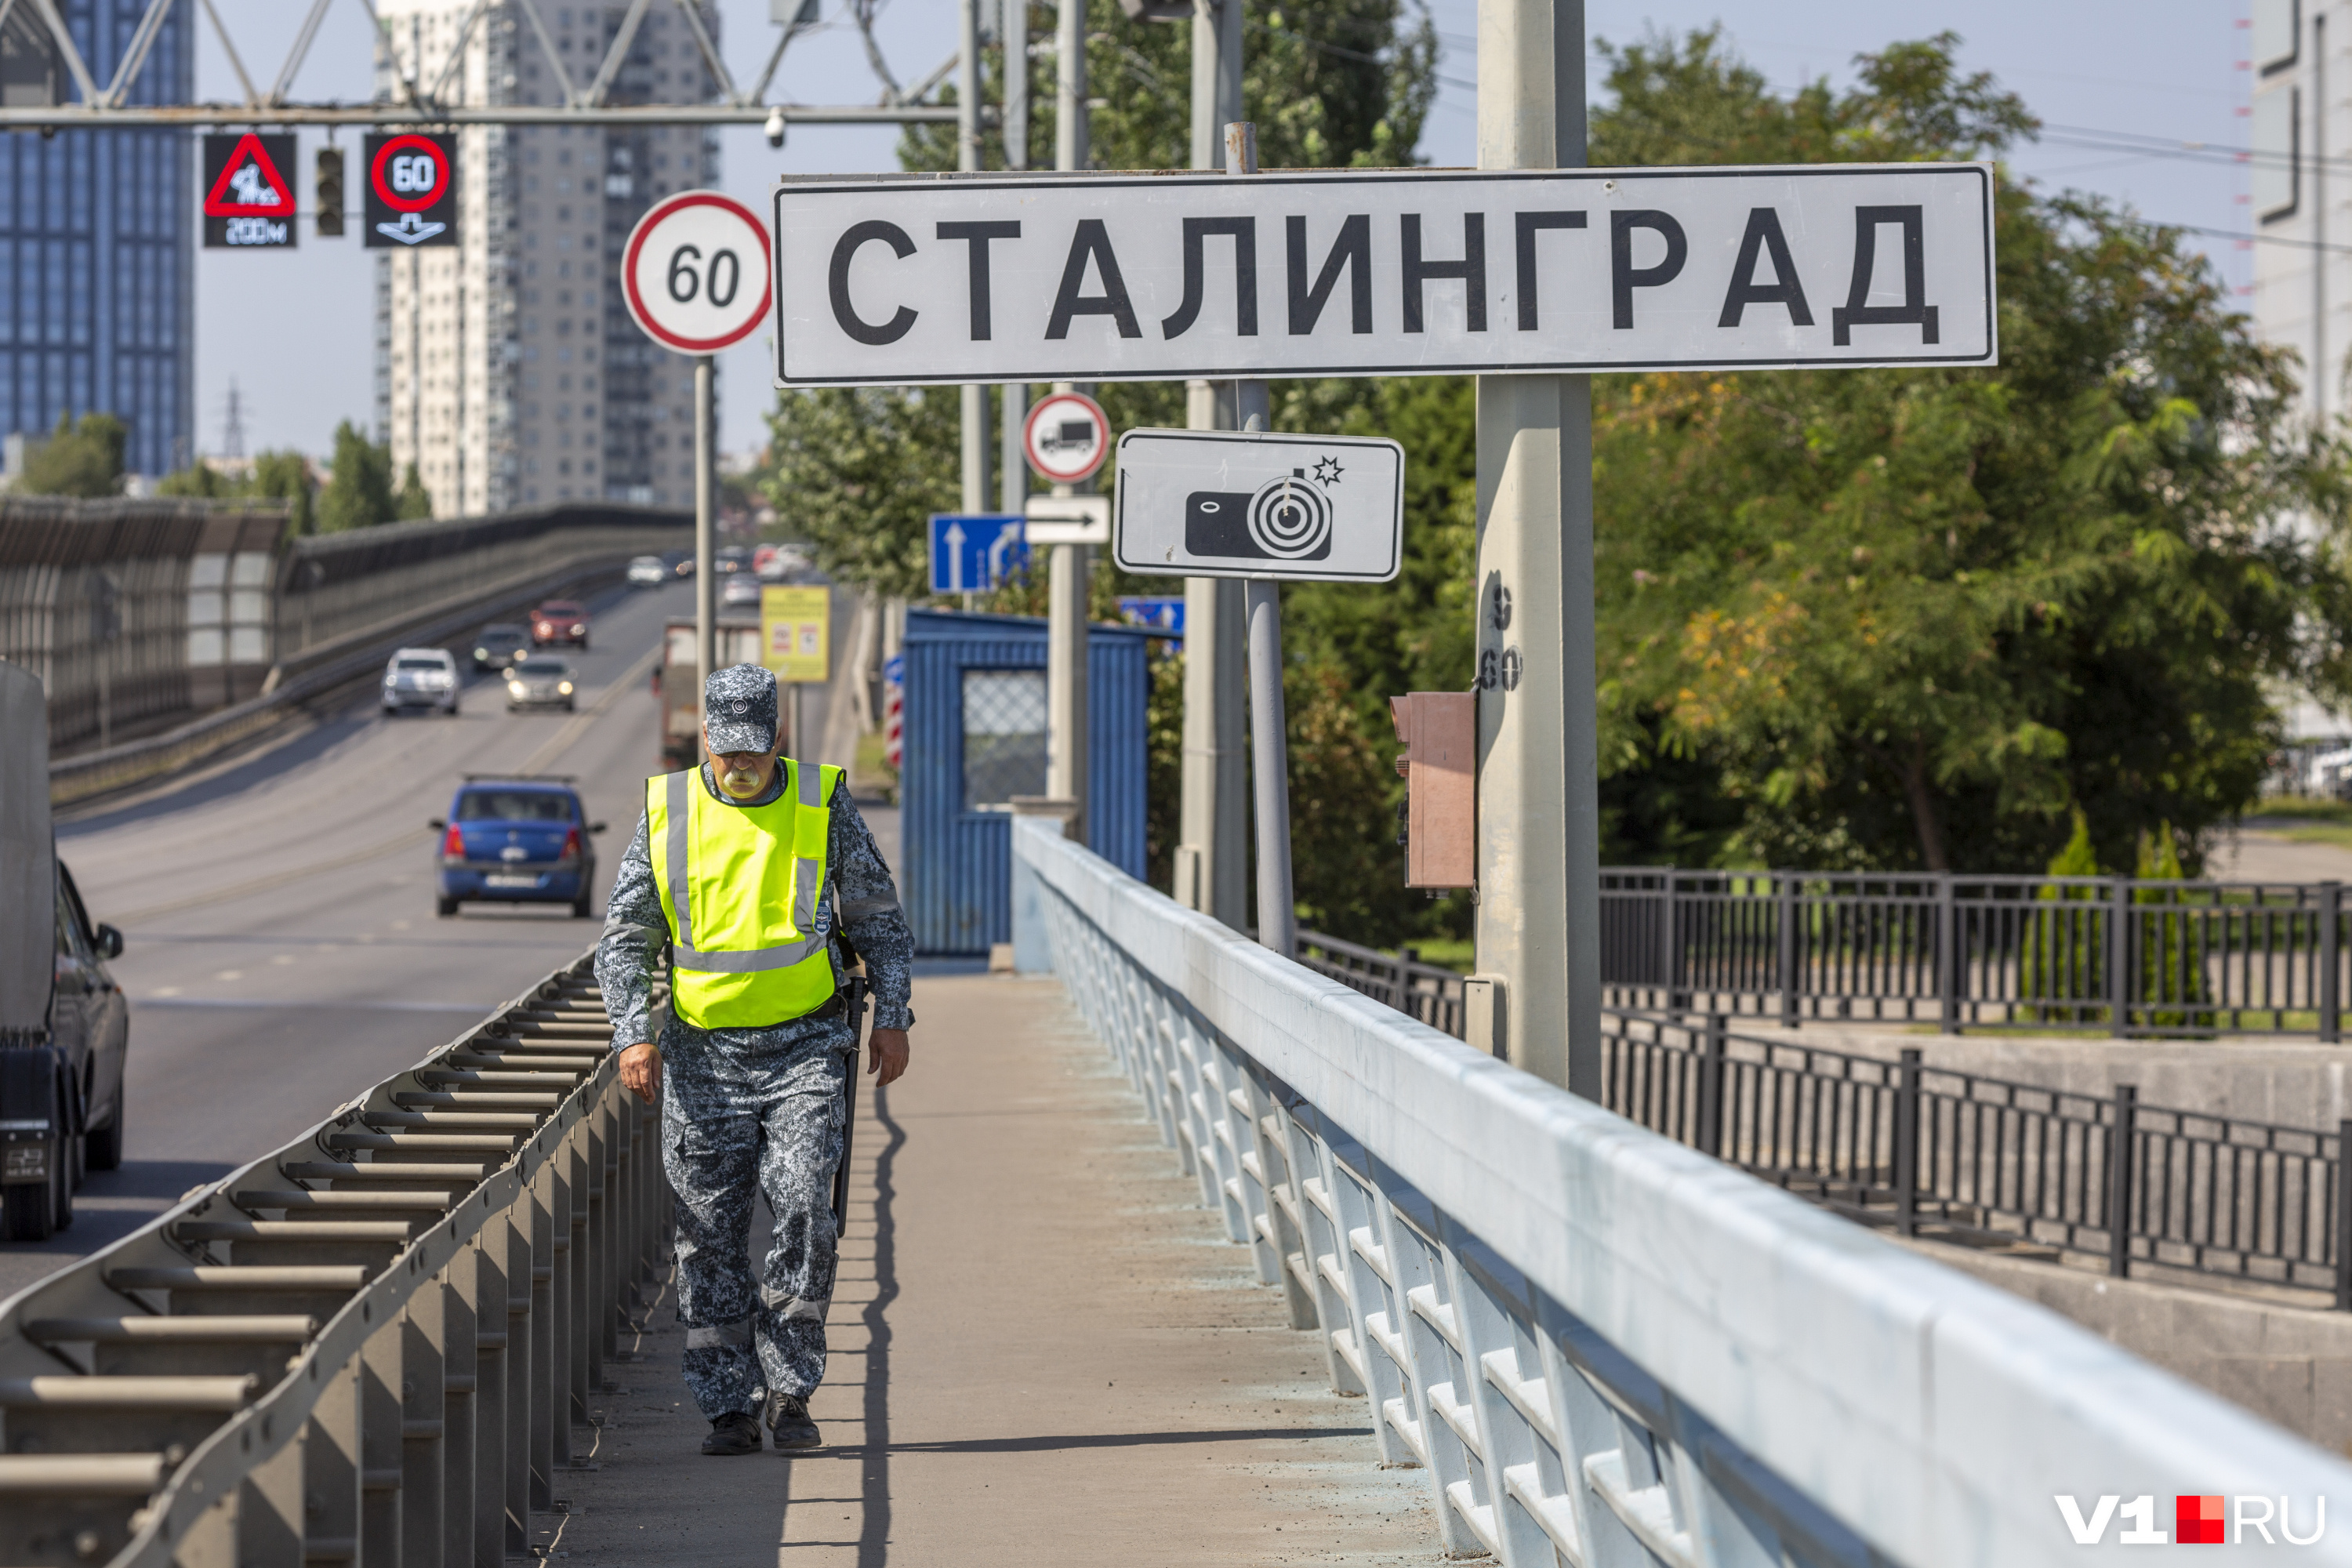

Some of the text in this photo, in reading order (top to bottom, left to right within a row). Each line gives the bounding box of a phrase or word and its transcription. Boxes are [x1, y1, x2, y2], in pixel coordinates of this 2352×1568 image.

[393, 155, 434, 192] 60
[667, 244, 739, 307] 60
[829, 204, 1940, 346] СТАЛИНГРАД
